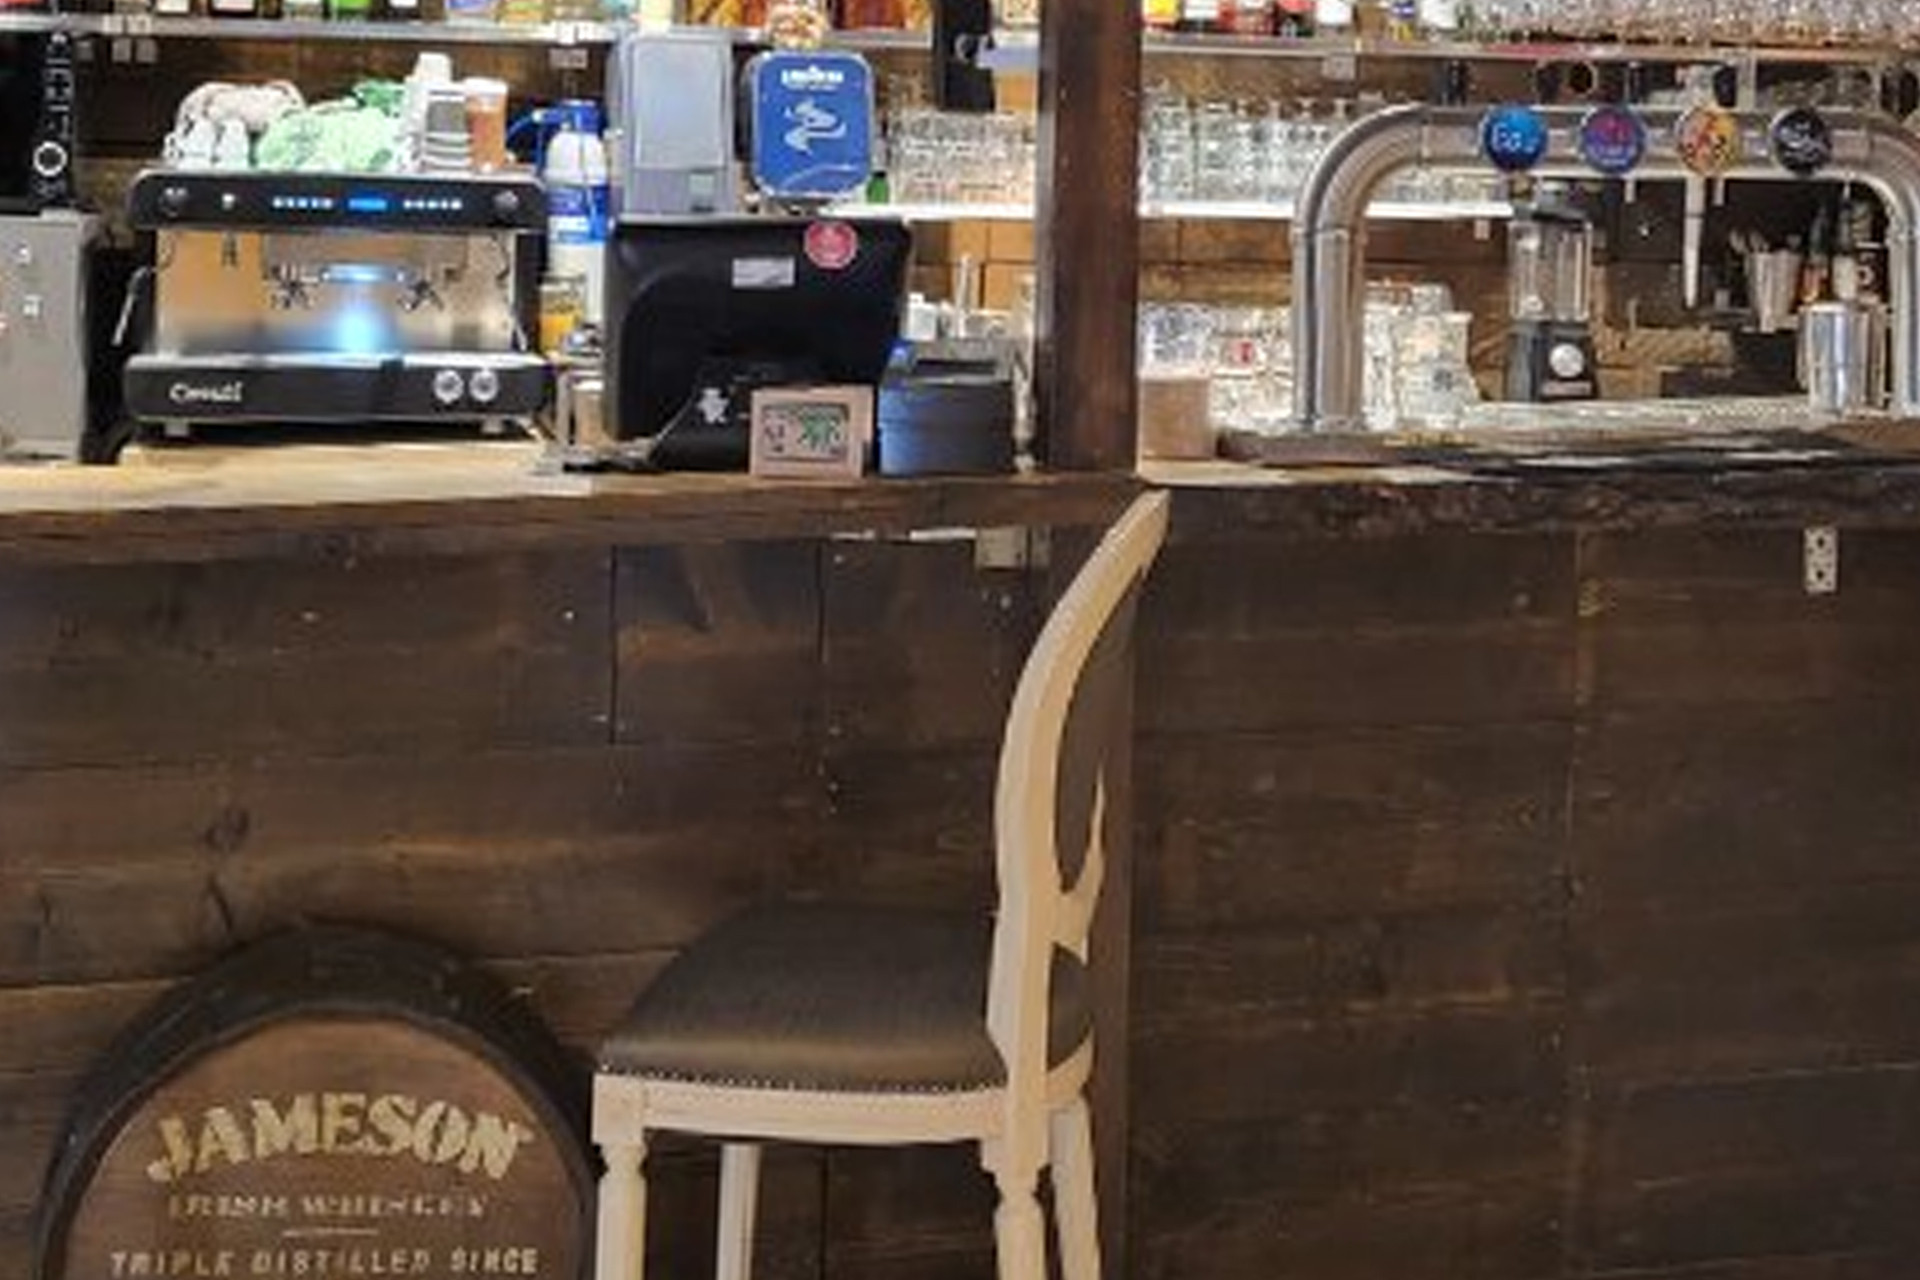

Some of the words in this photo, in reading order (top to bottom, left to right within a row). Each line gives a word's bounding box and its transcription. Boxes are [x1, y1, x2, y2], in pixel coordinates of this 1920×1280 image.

[147, 1092, 534, 1183] JAMESON
[168, 1195, 288, 1218] IRISH
[110, 1251, 233, 1277] TRIPLE
[250, 1250, 430, 1276] DISTILLED
[450, 1248, 539, 1274] SINCE
